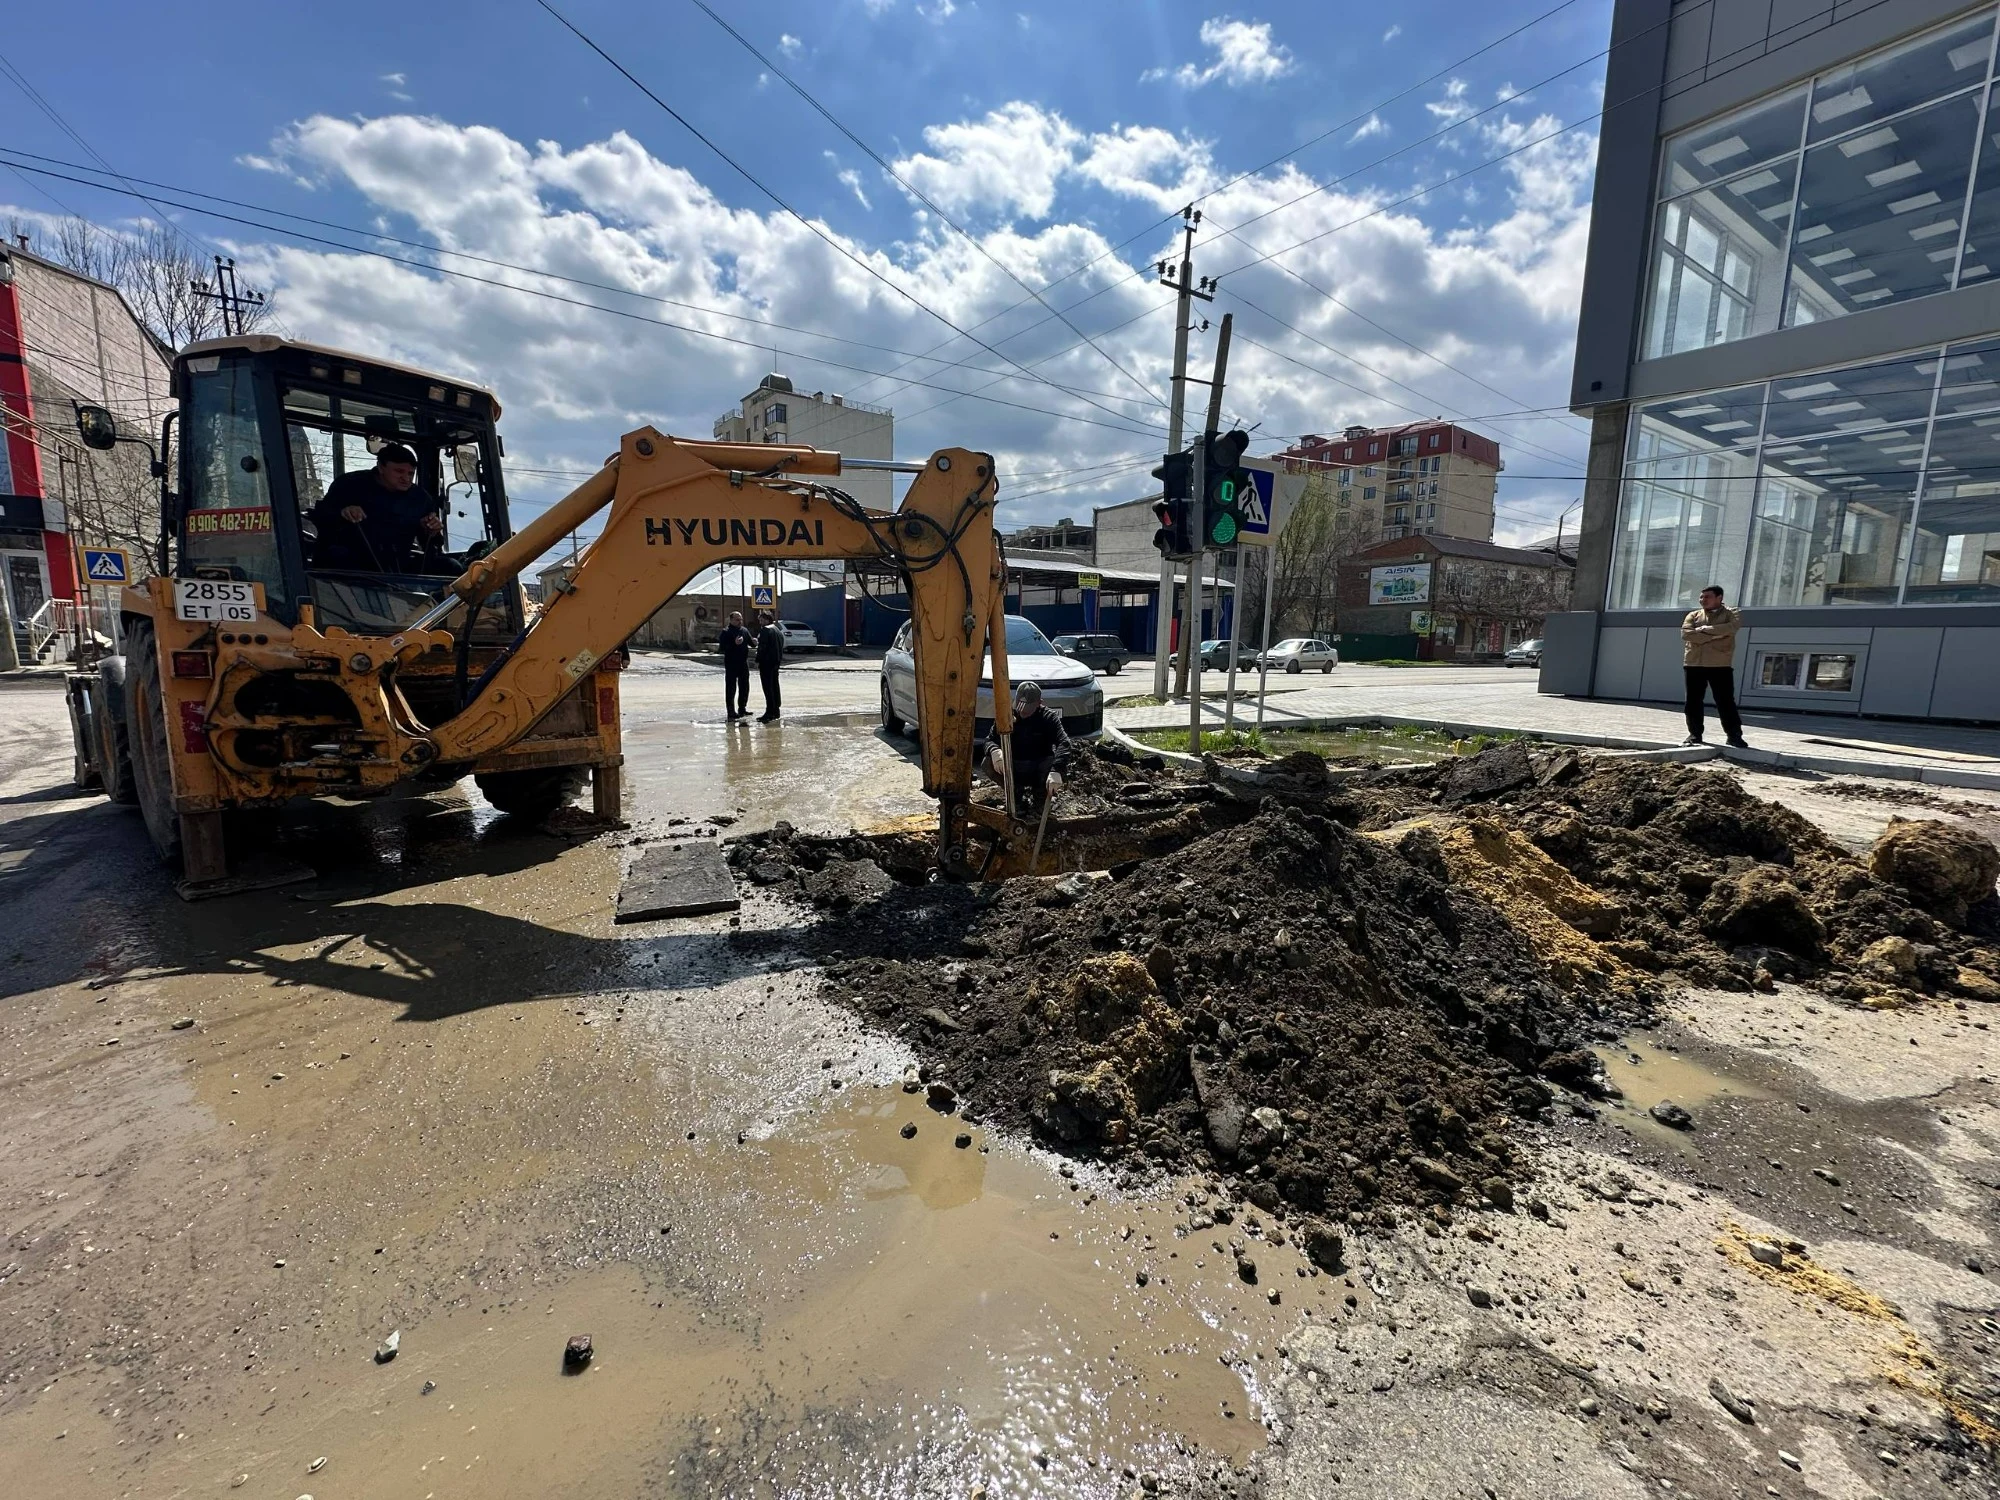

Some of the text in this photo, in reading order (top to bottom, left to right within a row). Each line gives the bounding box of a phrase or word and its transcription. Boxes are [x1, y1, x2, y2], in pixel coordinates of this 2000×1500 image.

[188, 511, 271, 533] 8 906 482-17-74
[645, 518, 824, 546] HYUNDAI
[1385, 566, 1416, 575] AISIN
[184, 582, 246, 601] 2855
[228, 606, 252, 620] 05
